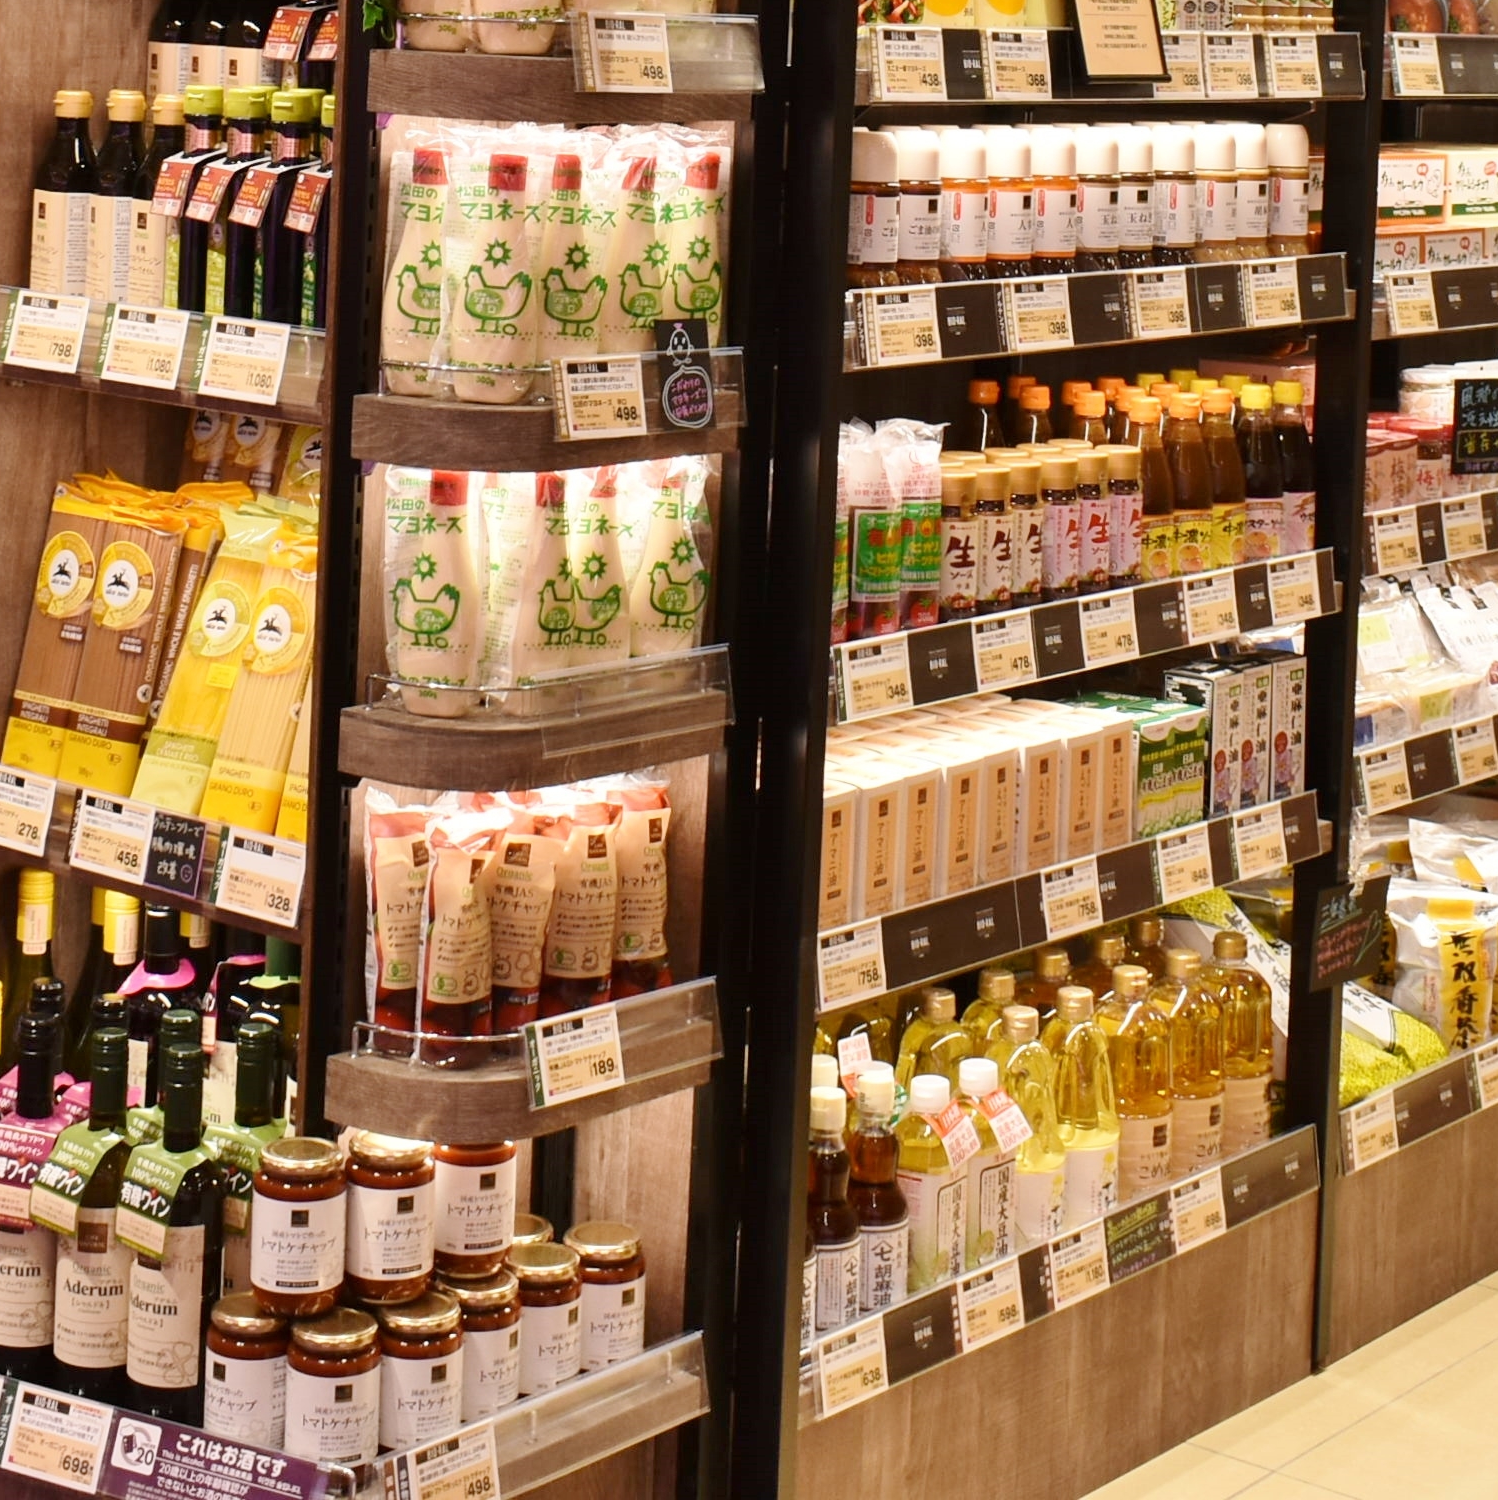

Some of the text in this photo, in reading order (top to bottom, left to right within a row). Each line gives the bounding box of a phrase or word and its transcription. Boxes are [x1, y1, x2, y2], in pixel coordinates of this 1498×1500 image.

[642, 64, 665, 81] 498
[459, 199, 543, 223] マヨネーズ
[546, 204, 618, 228] マヨネーズ
[1049, 320, 1067, 335] 398
[52, 343, 72, 358] 798
[915, 333, 934, 348] 398
[615, 405, 638, 423] 498
[387, 513, 464, 535] マヨネーズ
[17, 820, 39, 841] 278
[116, 848, 139, 868] 458
[267, 891, 291, 913] 328
[859, 969, 881, 985] 758
[591, 1058, 615, 1078] 189
[39, 1161, 83, 1197] 有機ワイン
[119, 1181, 171, 1219] 有機ワイン
[63, 1279, 125, 1300] Aderum
[861, 1367, 882, 1385] 638
[135, 1449, 154, 1466] 20
[175, 1433, 288, 1477] これはお酒です
[466, 1477, 492, 1498] 498
